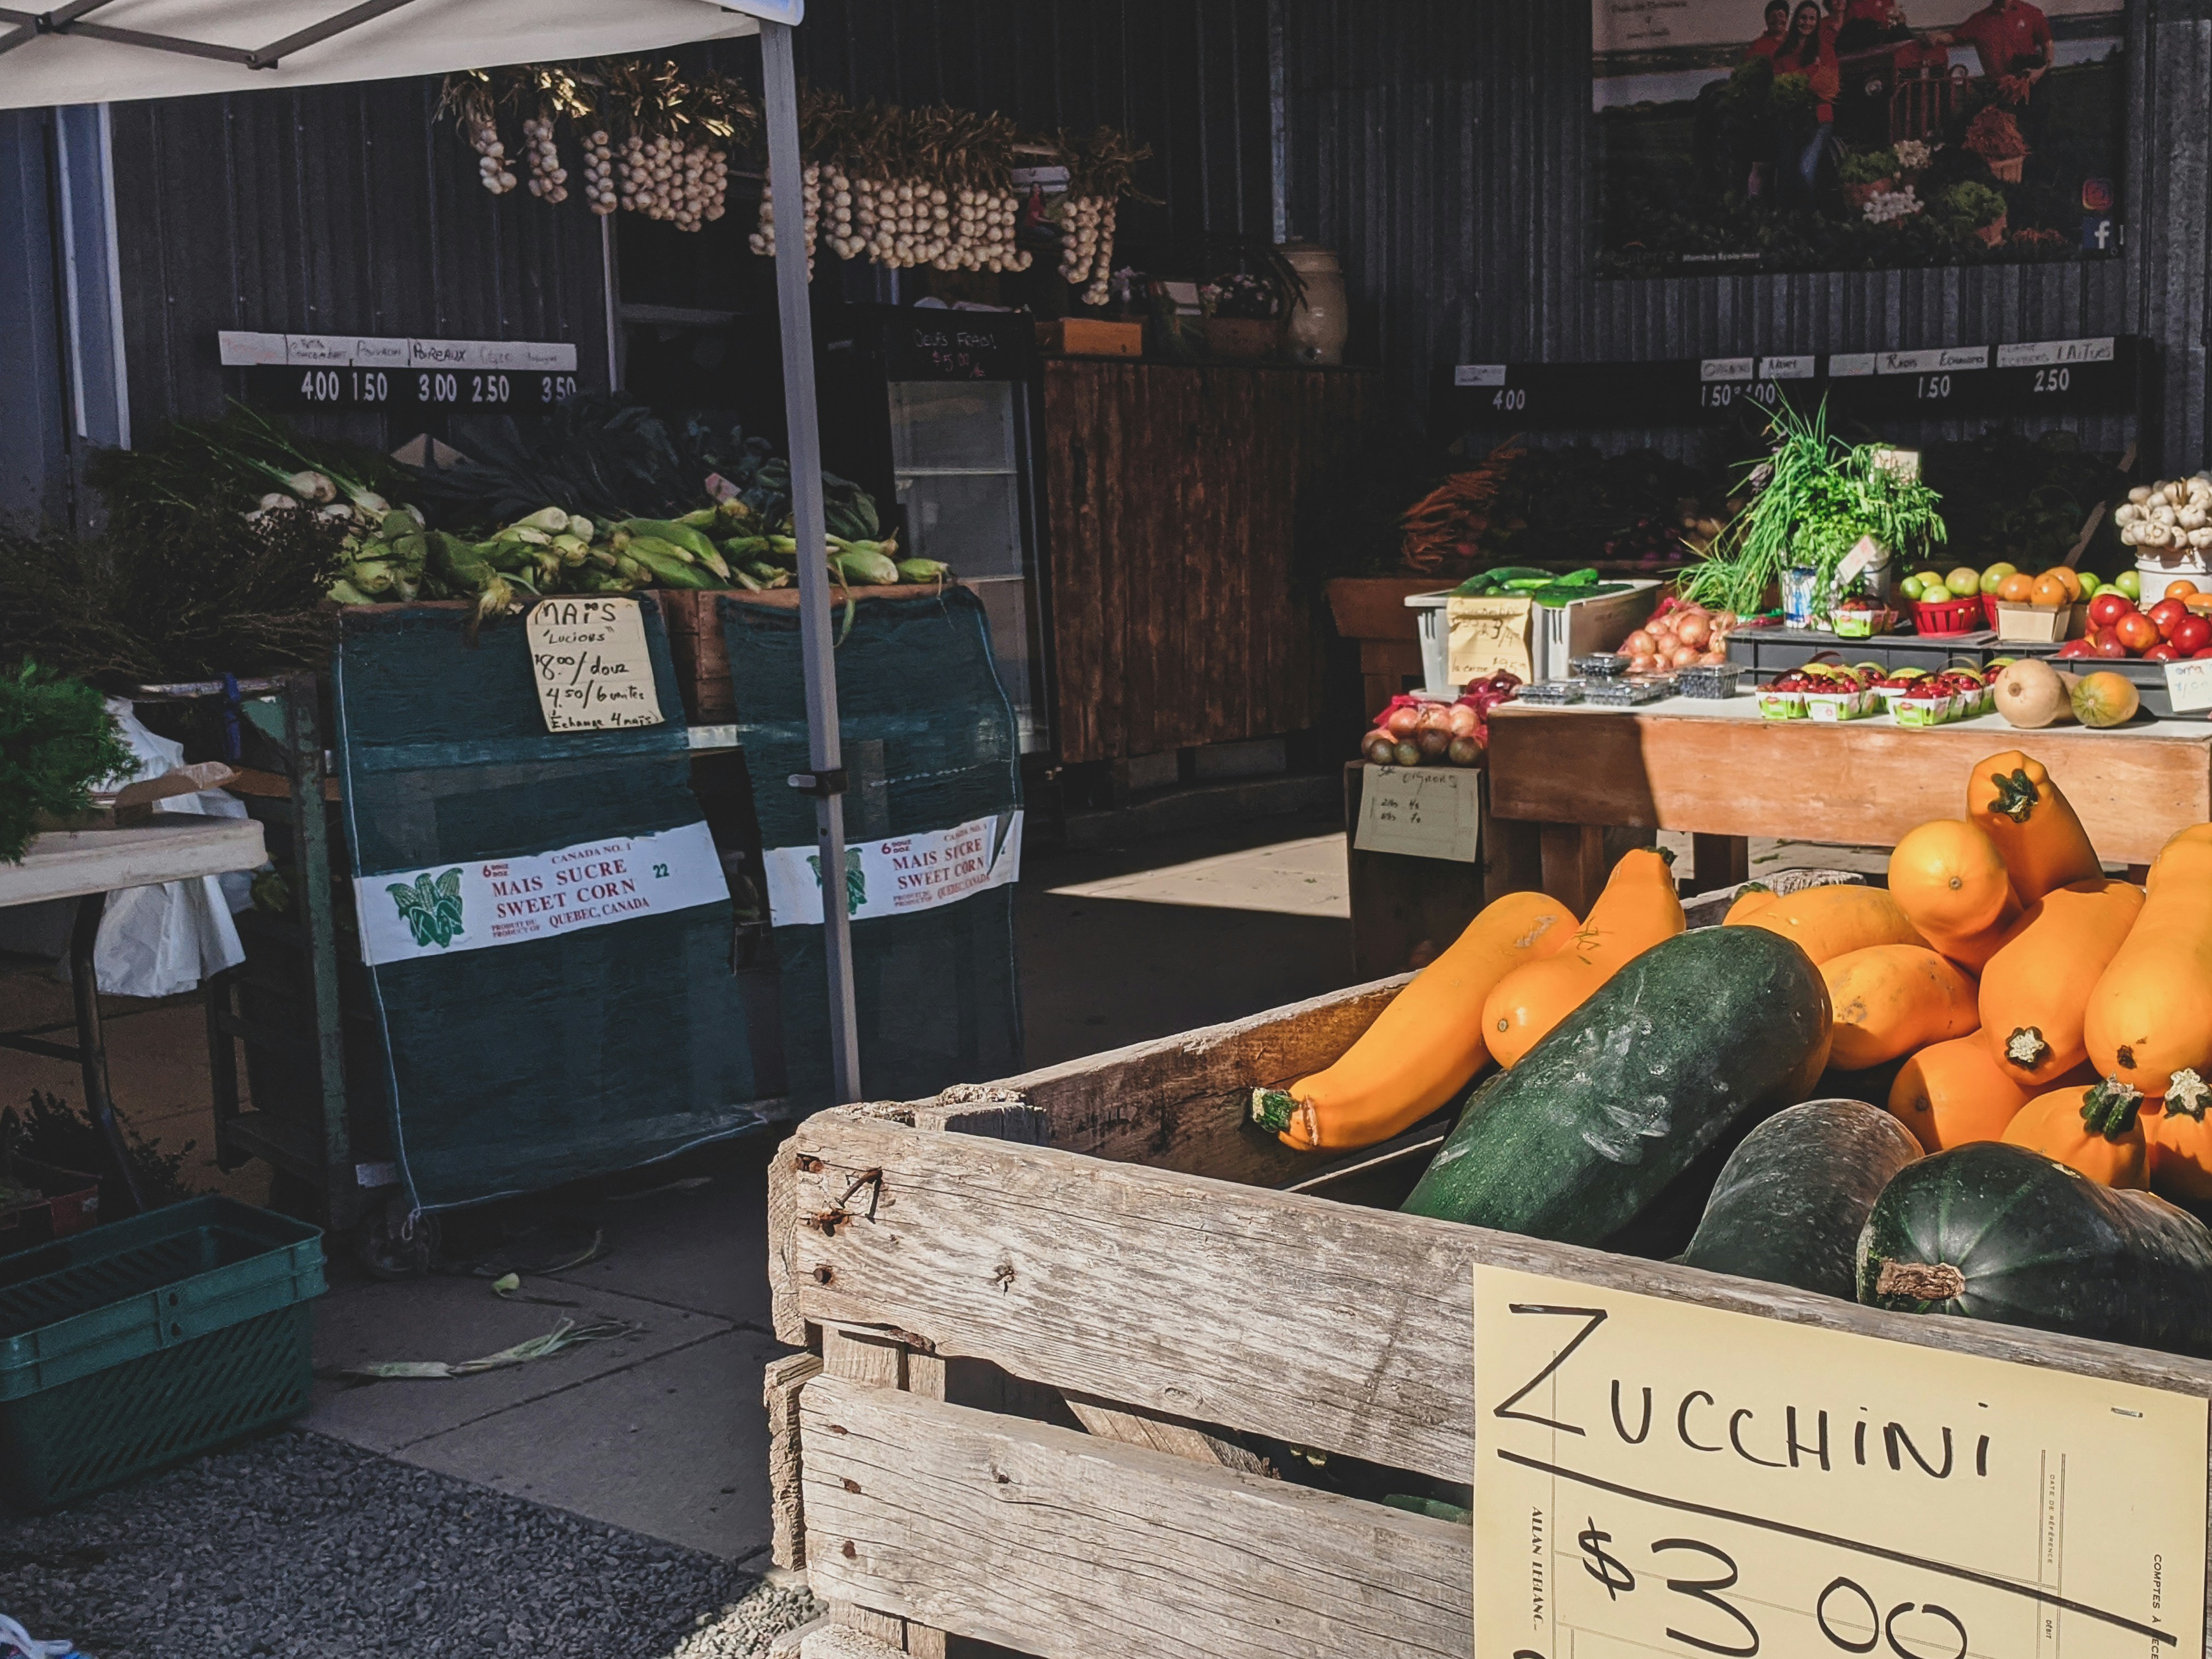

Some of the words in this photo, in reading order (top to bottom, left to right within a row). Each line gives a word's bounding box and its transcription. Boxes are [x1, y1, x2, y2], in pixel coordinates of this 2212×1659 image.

[552, 849, 601, 864] CANADA
[603, 844, 622, 853] NO.
[881, 843, 891, 854] 6
[893, 851, 937, 870] MAIS
[945, 838, 983, 861] SUCRE
[483, 865, 491, 878] 6
[492, 875, 543, 897] MAIS
[556, 859, 627, 885] SUCRE
[653, 863, 670, 880] 22
[898, 868, 950, 890] SWEET
[955, 856, 985, 877] CORN
[497, 892, 566, 919] SWEET
[578, 879, 636, 903] CORN
[549, 907, 601, 927] QUEBEC,
[603, 897, 649, 916] CANADA
[493, 928, 528, 938] PRODUCT
[2049, 1500, 2055, 1512] DE
[1531, 1506, 1543, 1555] ALLAN
[2046, 1515, 2055, 1564] RÉFÉRENCE
[2152, 1554, 2162, 1610] COMPTES
[2152, 1615, 2162, 1623] À
